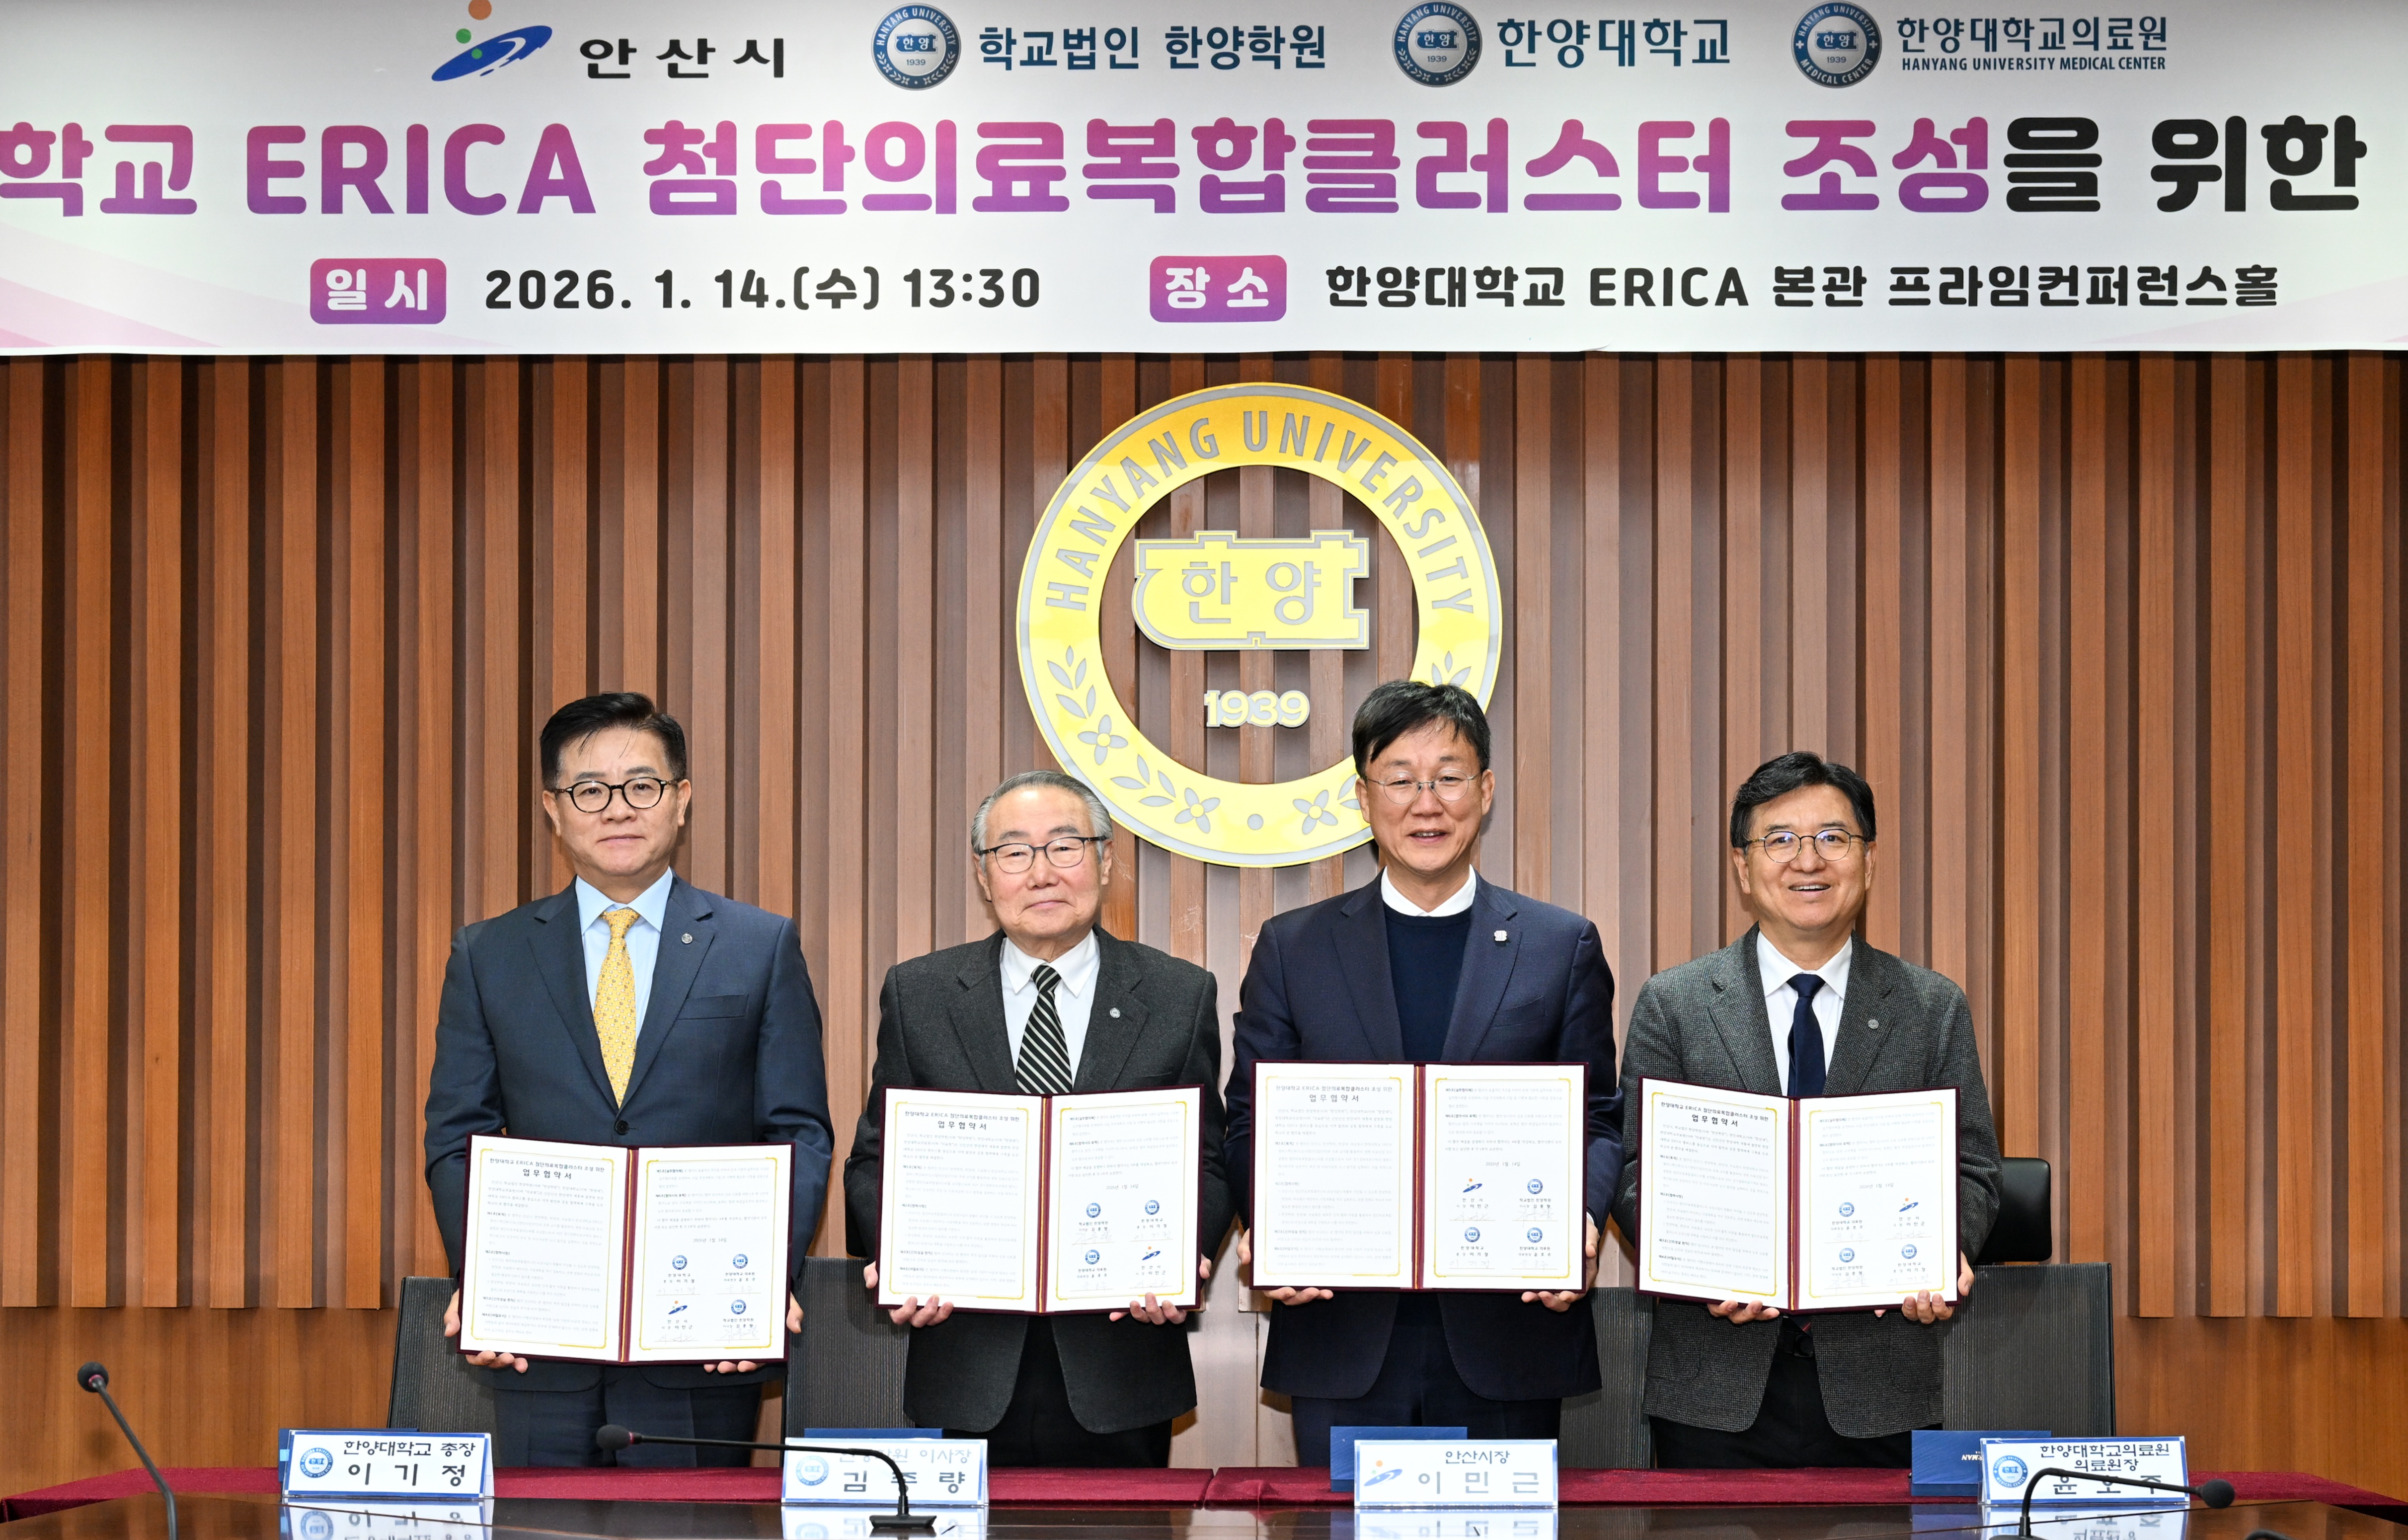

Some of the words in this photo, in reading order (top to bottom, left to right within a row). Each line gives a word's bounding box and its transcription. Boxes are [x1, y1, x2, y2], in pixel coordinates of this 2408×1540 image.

[876, 9, 909, 45] HANYANG
[912, 8, 956, 45] UNIVERSITY
[1397, 6, 1429, 42] HANYANG
[1433, 4, 1477, 41] UNIVERSITY
[1798, 7, 1830, 37] HANYANG
[1834, 5, 1876, 37] UNIVERSITY
[1897, 16, 2167, 53] 한양대학교의료원
[580, 38, 784, 79] 안산시
[903, 38, 930, 50] 한양
[980, 27, 1139, 71] 학교법인
[1165, 25, 1325, 70] 한양학원
[1424, 34, 1450, 46] 한양
[1497, 18, 1730, 68] 한양대학교
[1824, 35, 1850, 47] 한양
[1800, 59, 1838, 84] MEDICAL
[1842, 58, 1873, 82] CENTER
[1902, 58, 1967, 70] HANYANG
[1973, 57, 2055, 70] UNIVERSITY
[2060, 57, 2115, 70] MEDICAL
[2118, 57, 2166, 70] CENTER
[0, 122, 197, 217] 학교
[247, 123, 596, 216] ERICA
[643, 117, 1730, 215] 첨단의료복합클러스터
[1781, 116, 2102, 213] 조성을
[2151, 115, 2367, 213] 위한
[326, 269, 427, 310] 일시
[486, 270, 630, 309] 2026.
[655, 270, 690, 308] 1.
[715, 267, 878, 309] 14.(수)
[904, 268, 1039, 308] 13:30
[1166, 267, 1268, 308] 장소
[1326, 266, 1564, 307] 한양대학교
[1590, 267, 1748, 307] ERICA
[1773, 266, 1866, 307] 본관
[1889, 265, 2277, 307] 프라임컨퍼런스홀
[1045, 418, 1220, 611] HANYANG
[1243, 410, 1474, 615] UNIVERSITY
[1181, 560, 1322, 625] 한양
[1205, 690, 1310, 727] 1939
[344, 1441, 431, 1456] 한양대학교
[441, 1443, 475, 1457] 총장
[920, 1449, 972, 1463] 이사장
[1446, 1451, 1509, 1463] 안산시장
[2040, 1444, 2170, 1458] 한양대학교의료원
[2074, 1459, 2139, 1472] 의료원장
[349, 1463, 465, 1486] 이기정
[1418, 1472, 1539, 1494] 이민근
